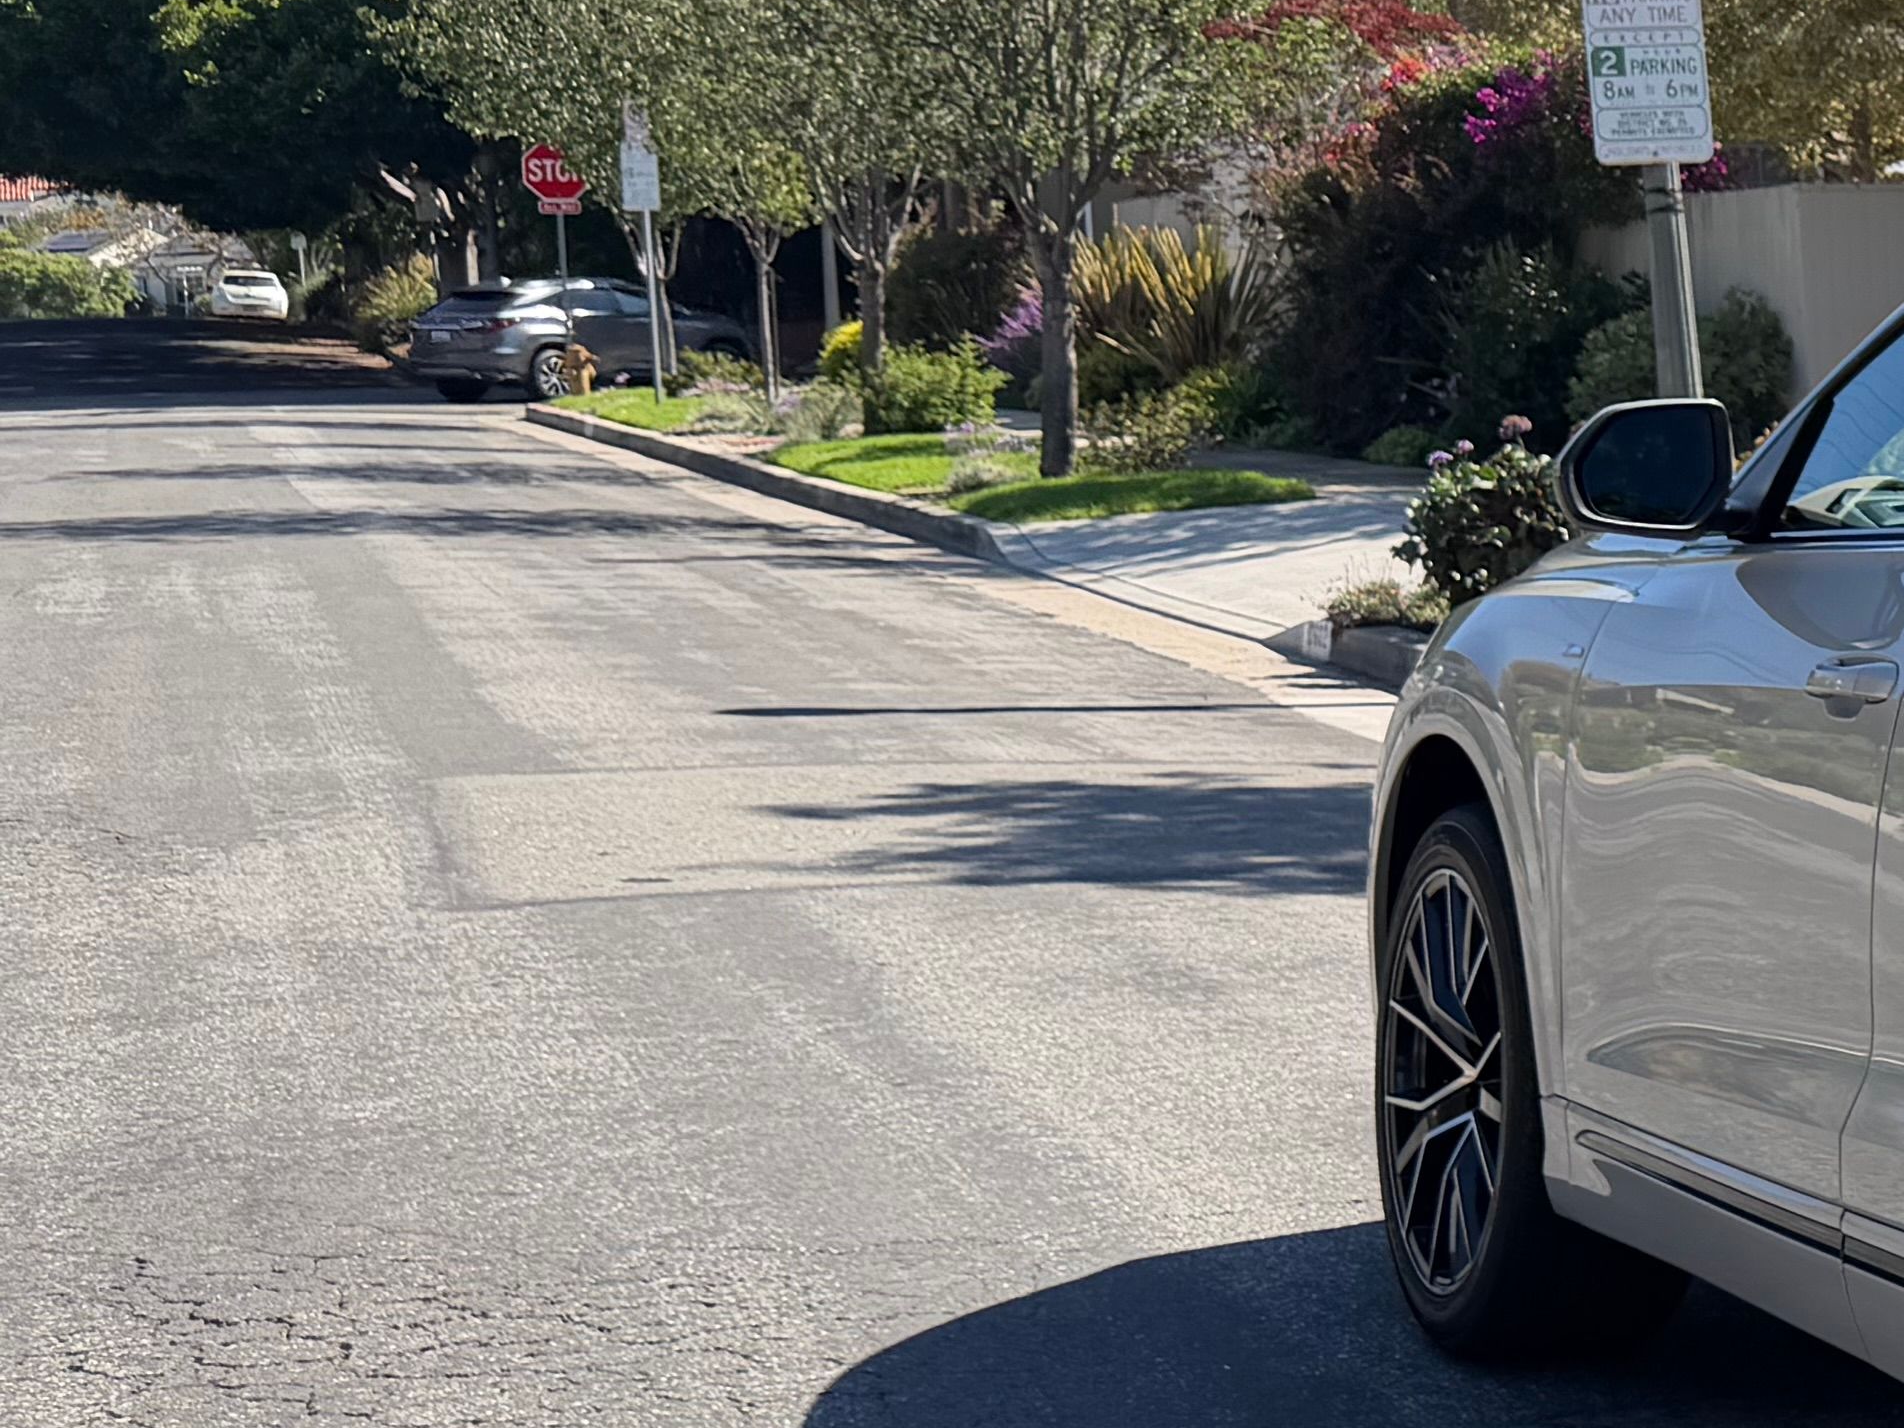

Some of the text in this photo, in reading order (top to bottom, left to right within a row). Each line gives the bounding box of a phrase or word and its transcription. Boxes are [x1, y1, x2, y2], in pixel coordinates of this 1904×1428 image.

[1600, 5, 1688, 24] ANY TIME
[1600, 50, 1698, 76] 2 PARKING
[1603, 80, 1635, 100] 8AM
[1666, 79, 1699, 98] 6PM
